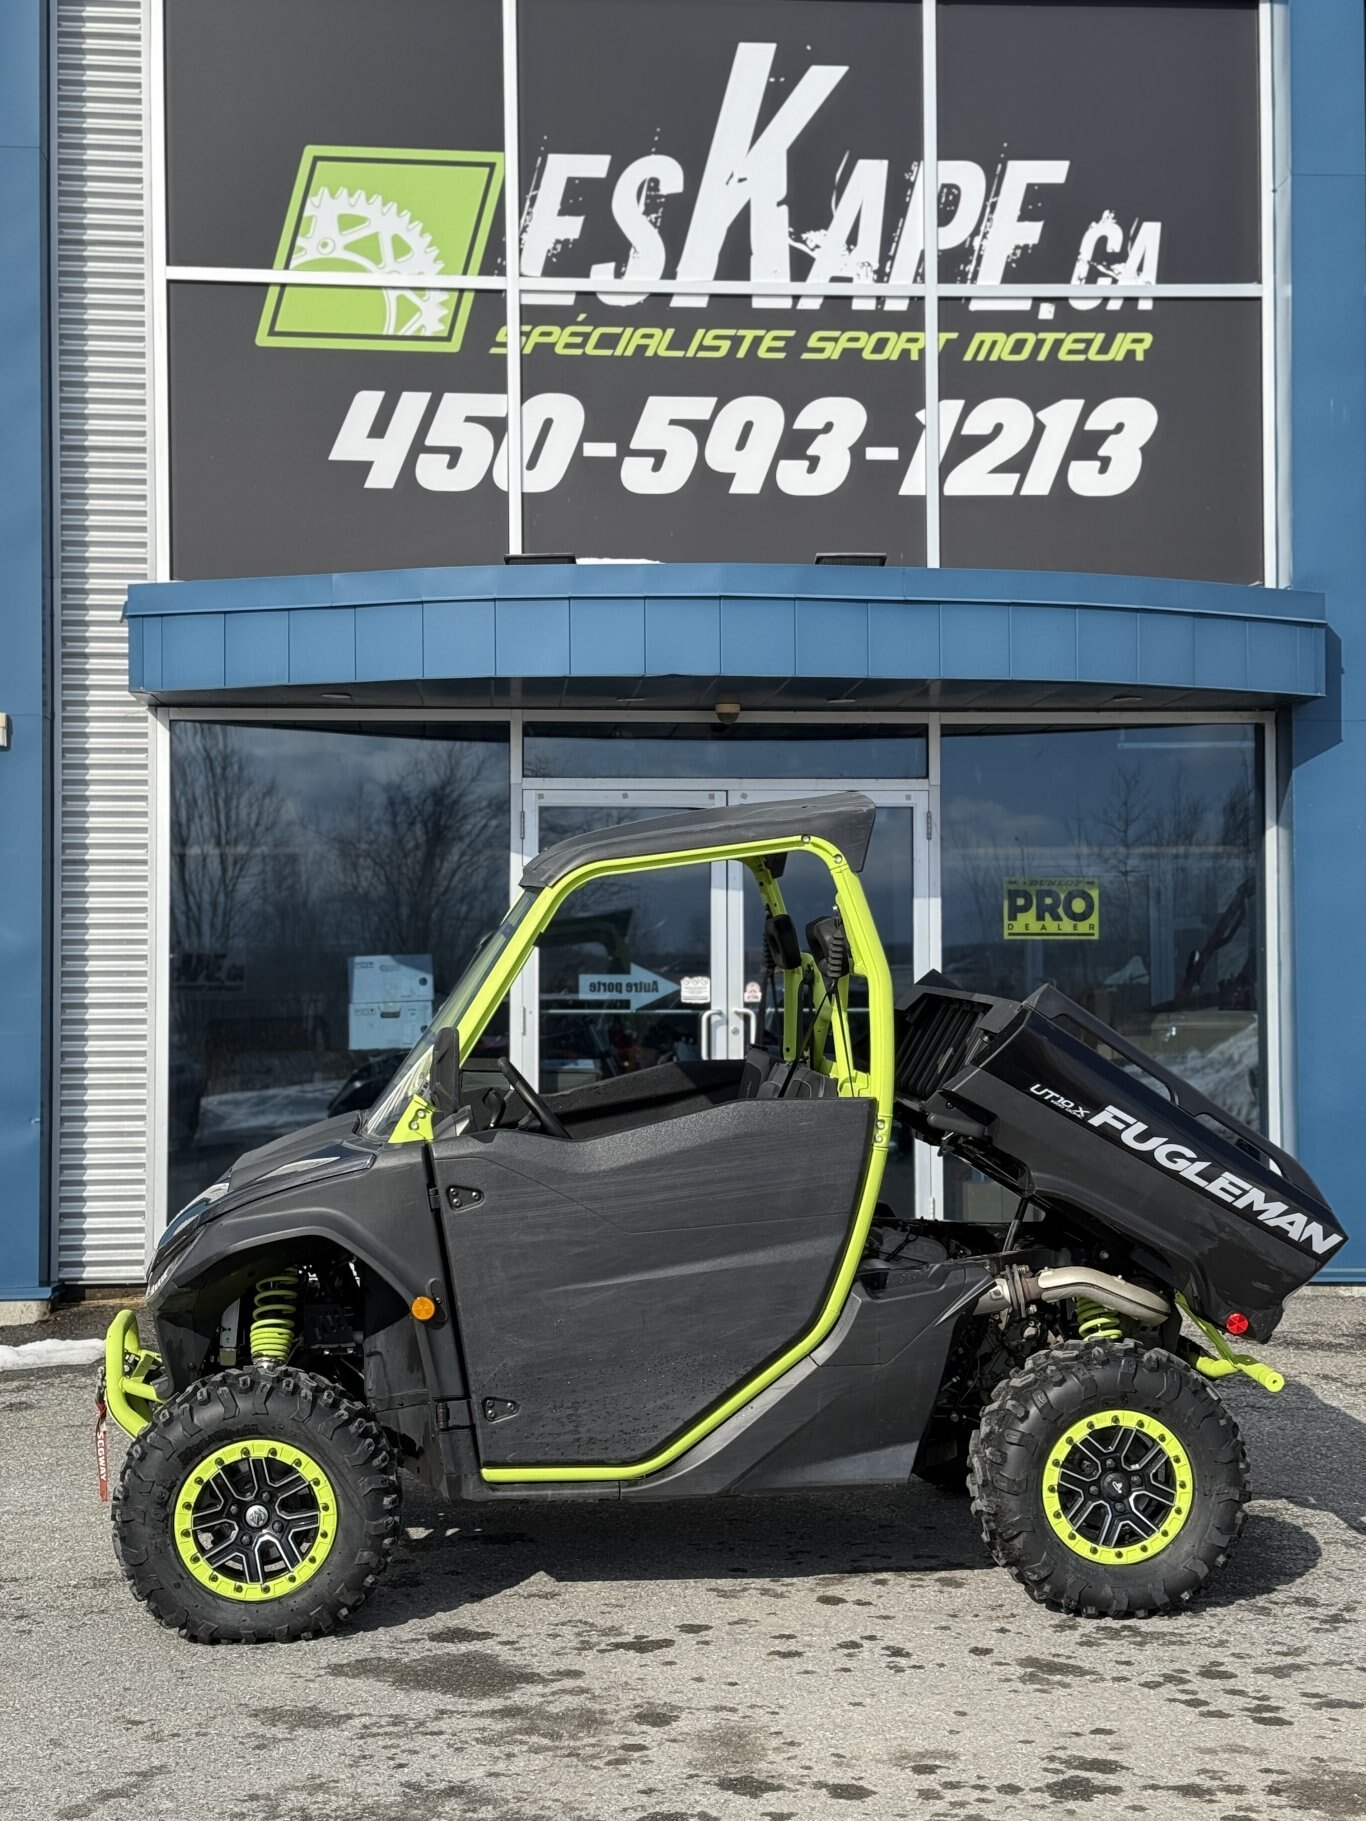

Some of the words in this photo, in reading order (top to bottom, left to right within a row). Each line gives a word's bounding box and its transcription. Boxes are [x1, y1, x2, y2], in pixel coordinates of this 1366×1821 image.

[489, 315, 795, 358] SPÉCIALISTE
[964, 331, 1152, 361] MOTEUR
[329, 389, 1158, 496] 450-593-1213
[1007, 889, 1095, 922] PRO
[1007, 923, 1095, 931] DEALER
[1088, 1105, 1343, 1254] FUGLEMAN
